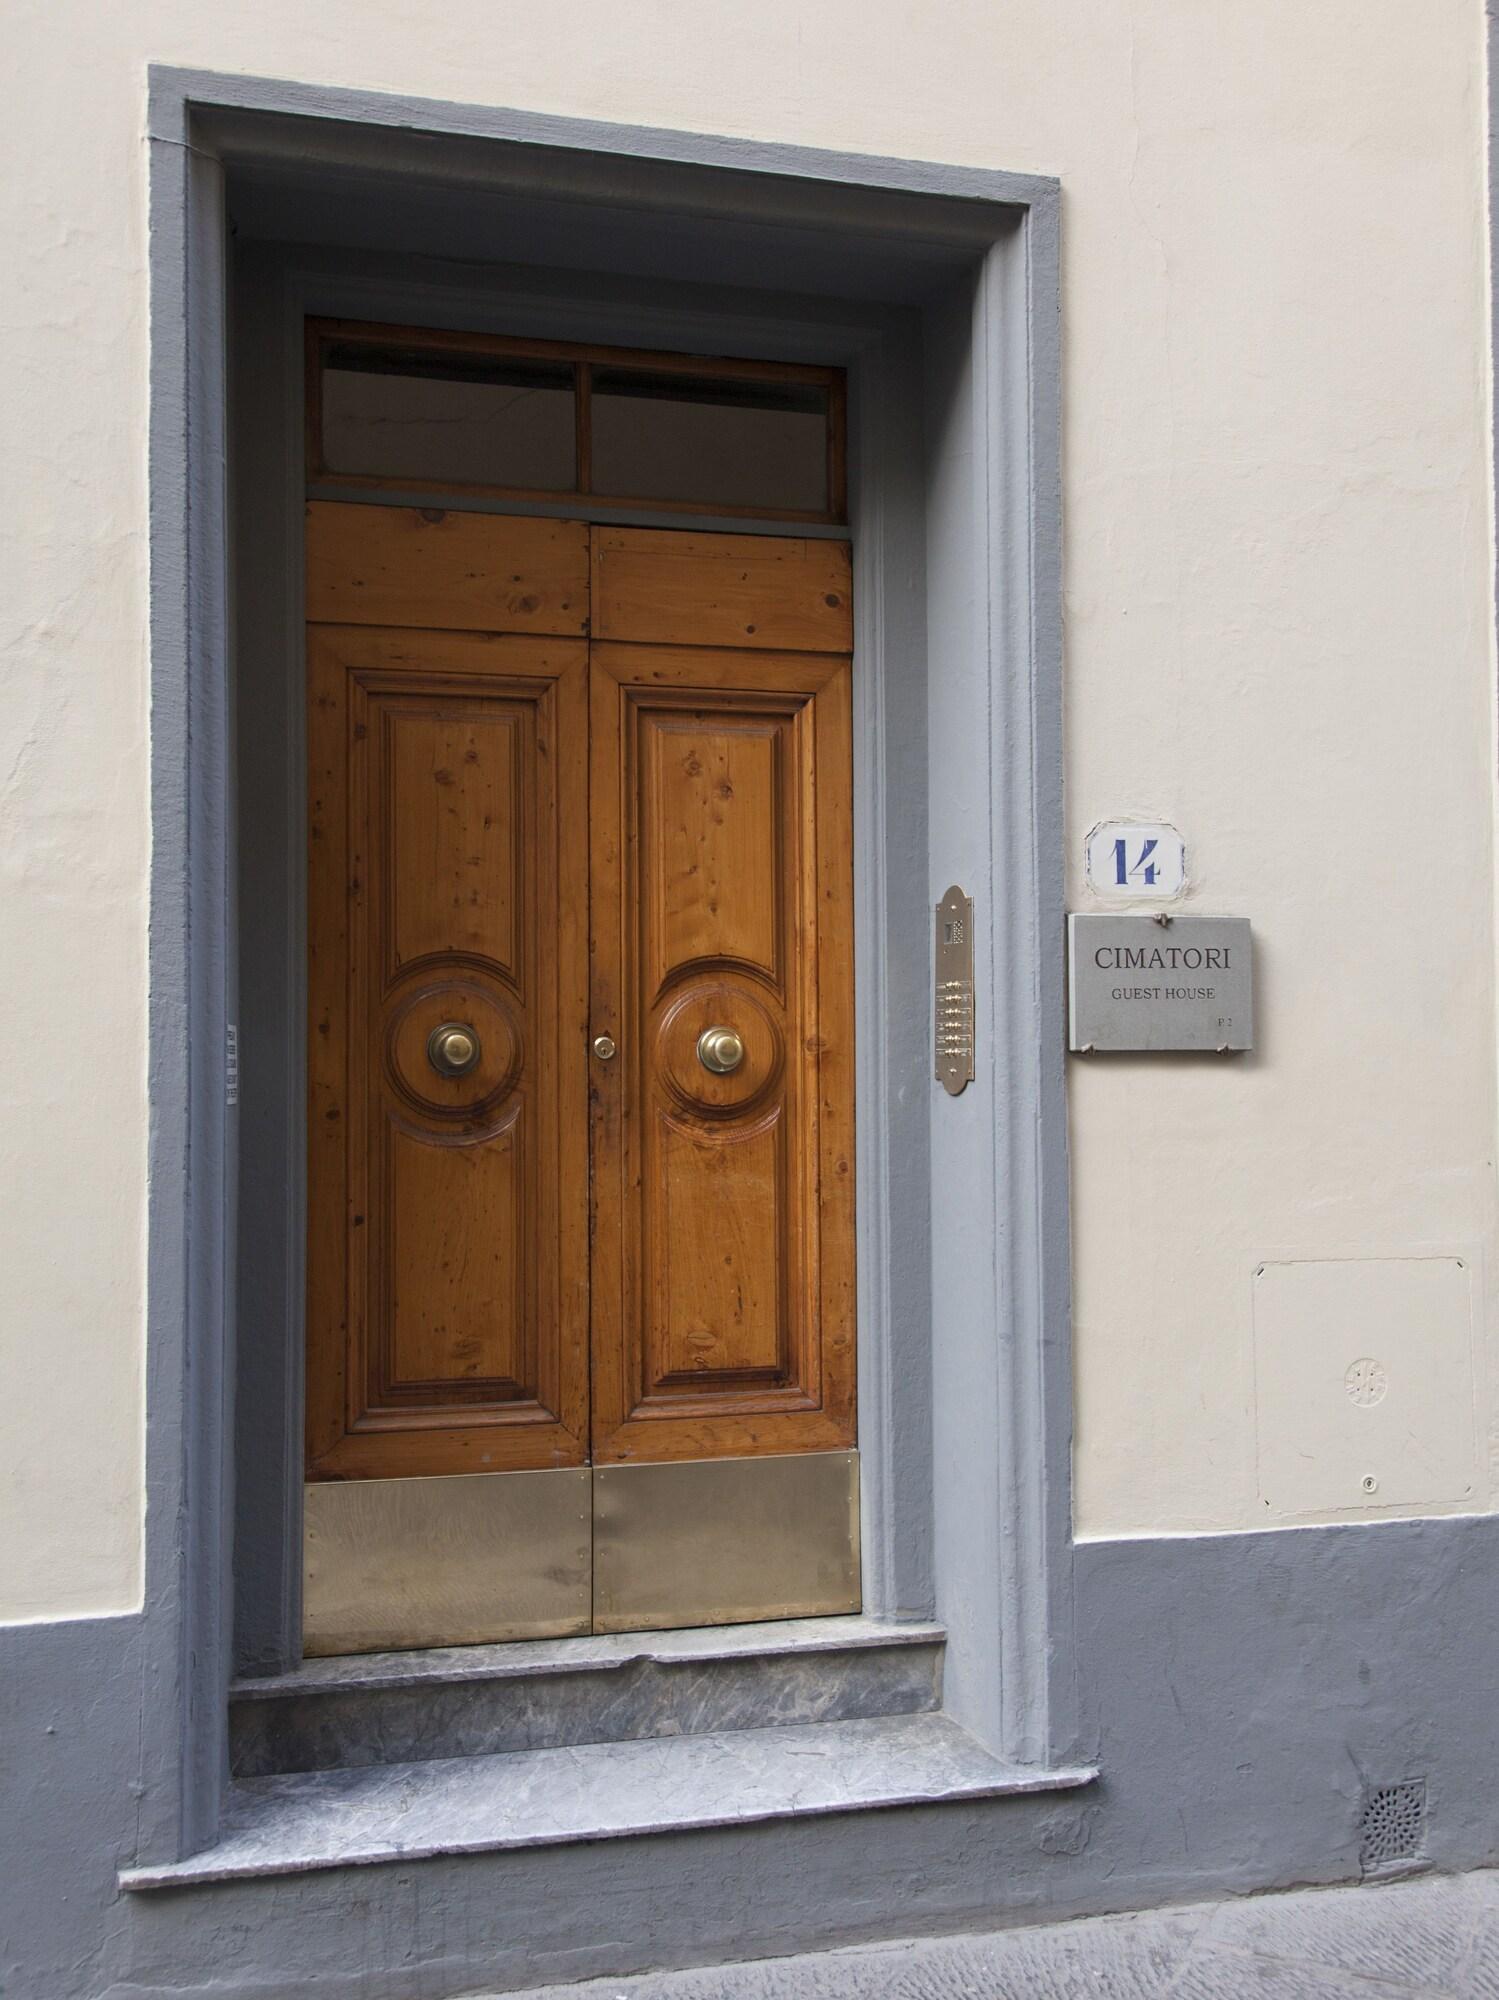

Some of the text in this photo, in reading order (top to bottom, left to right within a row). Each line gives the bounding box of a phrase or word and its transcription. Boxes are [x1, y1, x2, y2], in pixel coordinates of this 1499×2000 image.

[1109, 839, 1161, 885] 14
[1094, 947, 1232, 969] CIMATORI
[1111, 987, 1216, 1000] GUEST HOUSE
